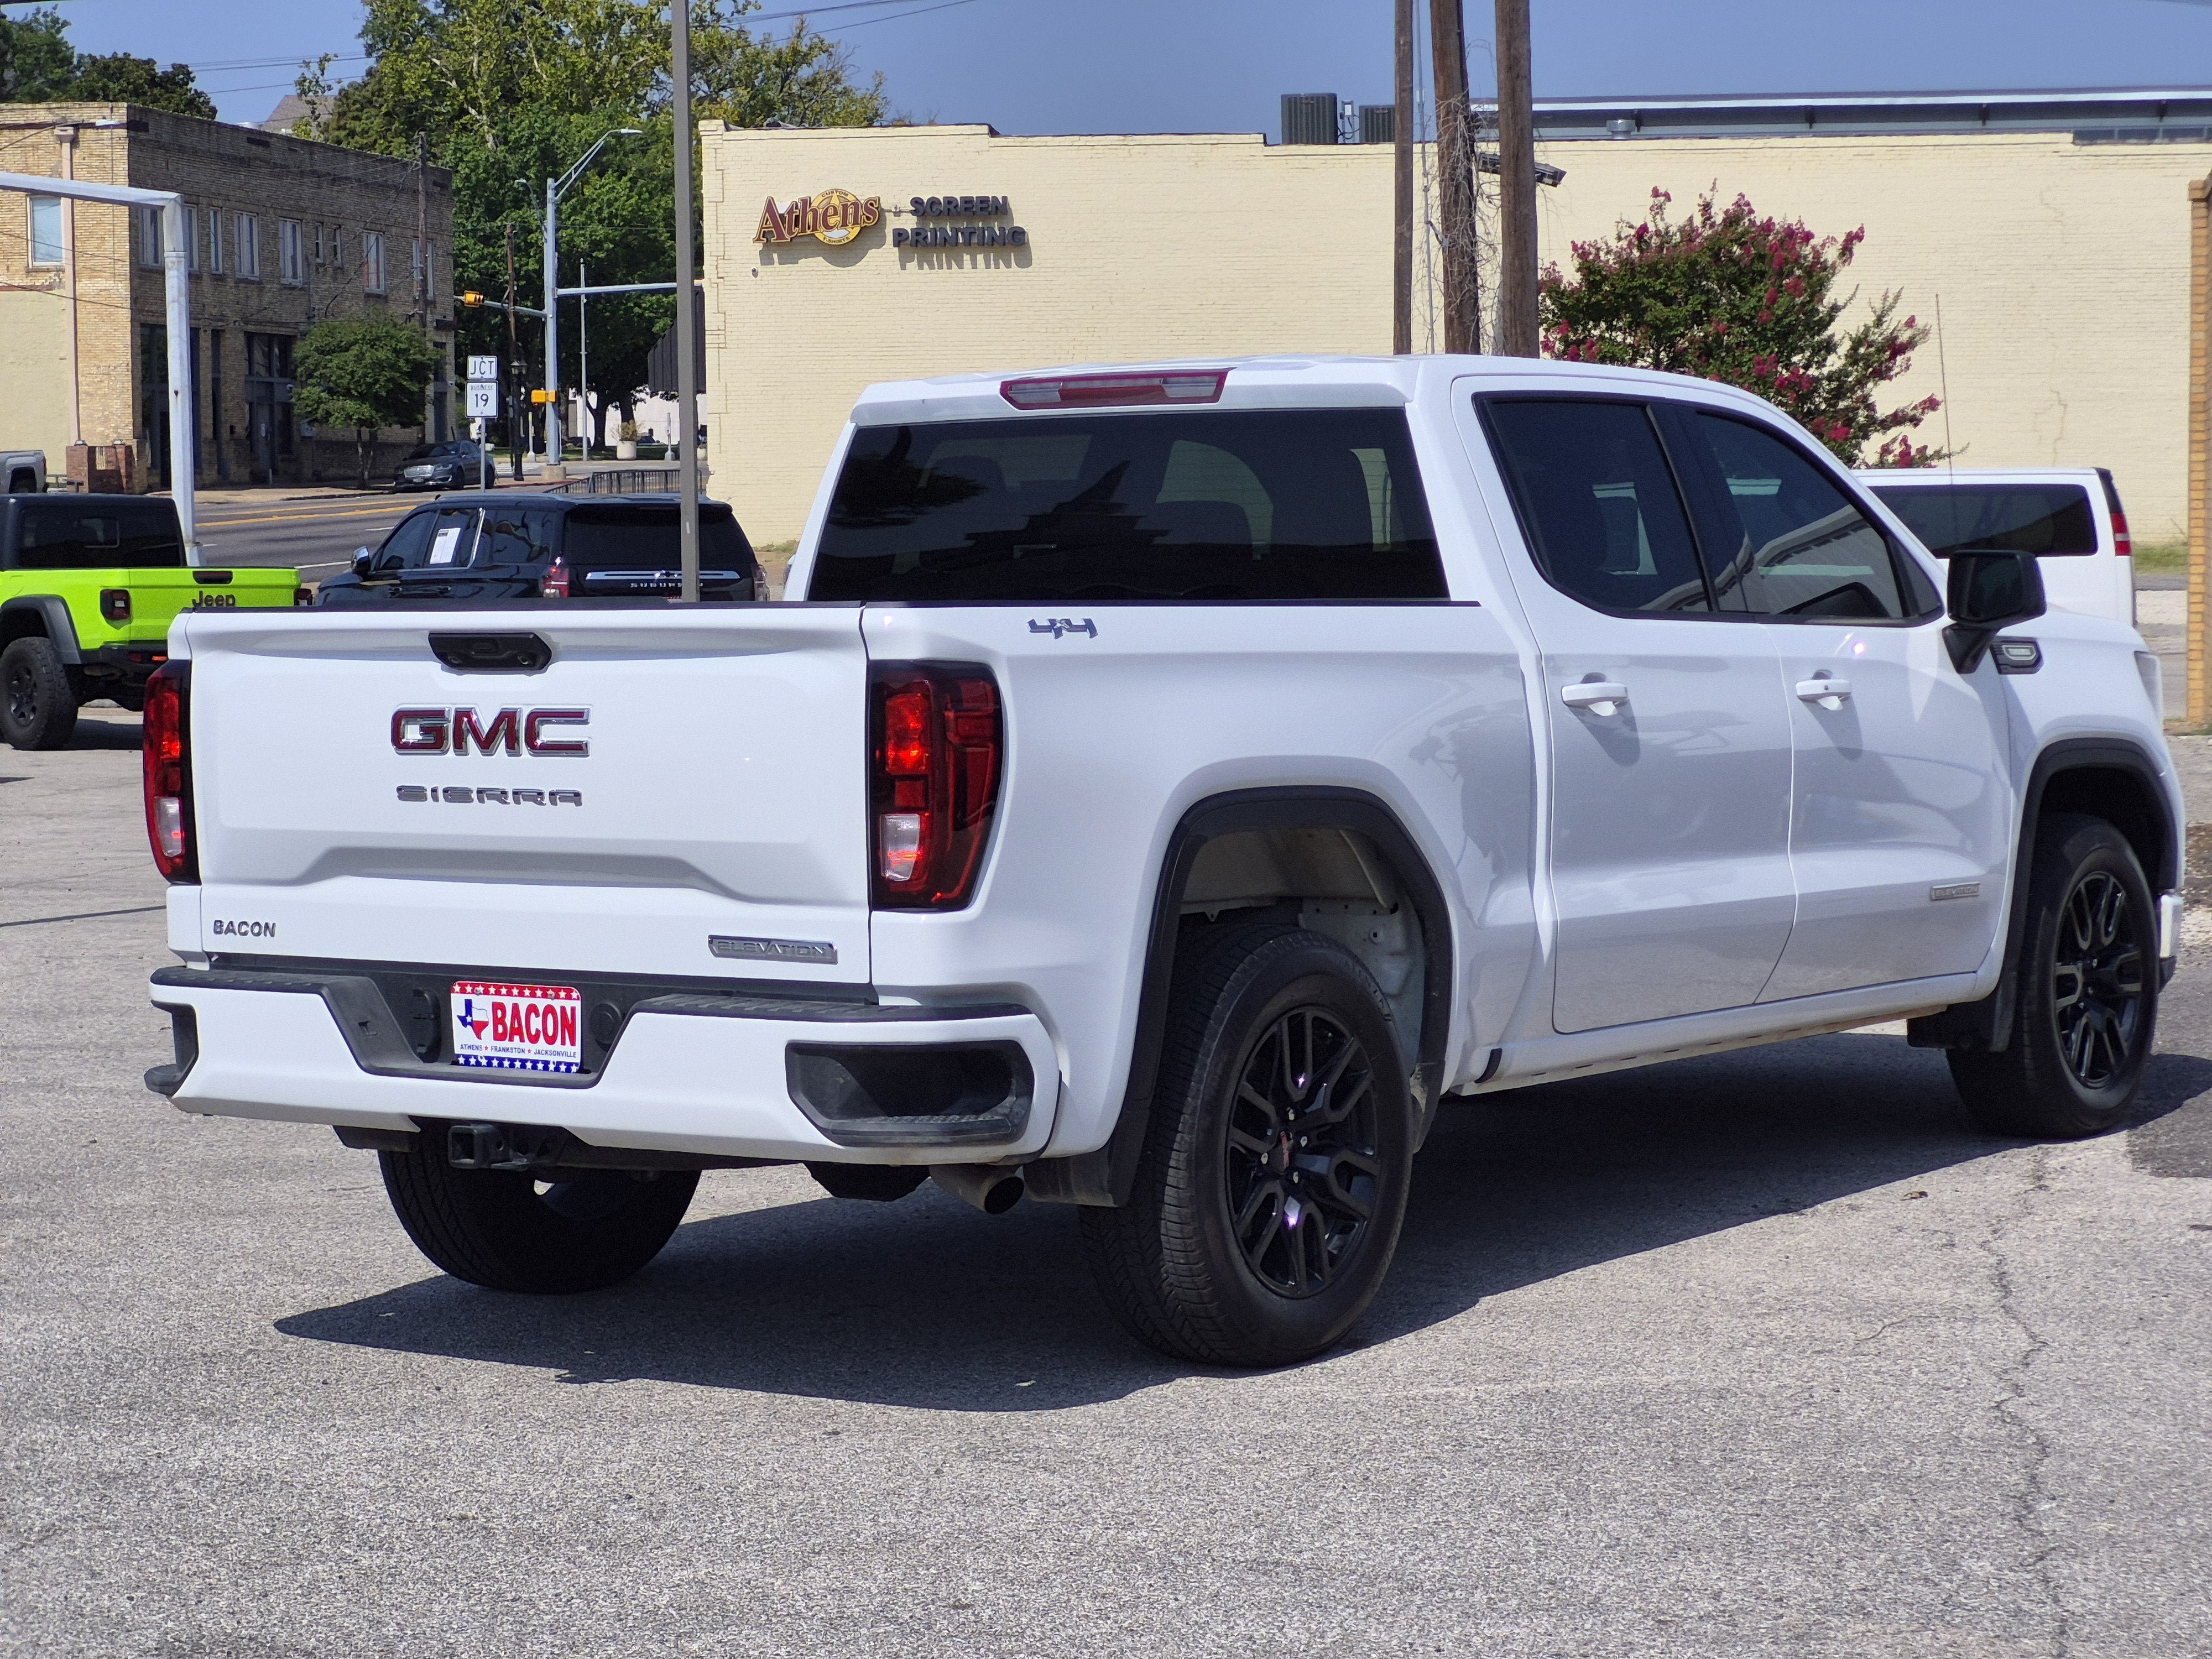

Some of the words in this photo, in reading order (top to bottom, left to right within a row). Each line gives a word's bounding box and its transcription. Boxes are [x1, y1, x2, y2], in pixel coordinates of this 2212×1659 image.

[910, 195, 1008, 217] SCREEN
[752, 196, 881, 243] Athens
[893, 226, 1027, 247] PRINTING
[470, 361, 494, 375] JCT
[474, 393, 489, 408] 19
[192, 590, 236, 608] Jeep
[391, 707, 591, 757] GMC
[396, 785, 583, 807] SIERRA
[213, 920, 276, 938] BACON
[718, 941, 827, 957] ELEVATION
[492, 1001, 576, 1047] BACON
[491, 1045, 525, 1054] FRANKSTON
[534, 1049, 576, 1058] JACKSONVILLE
